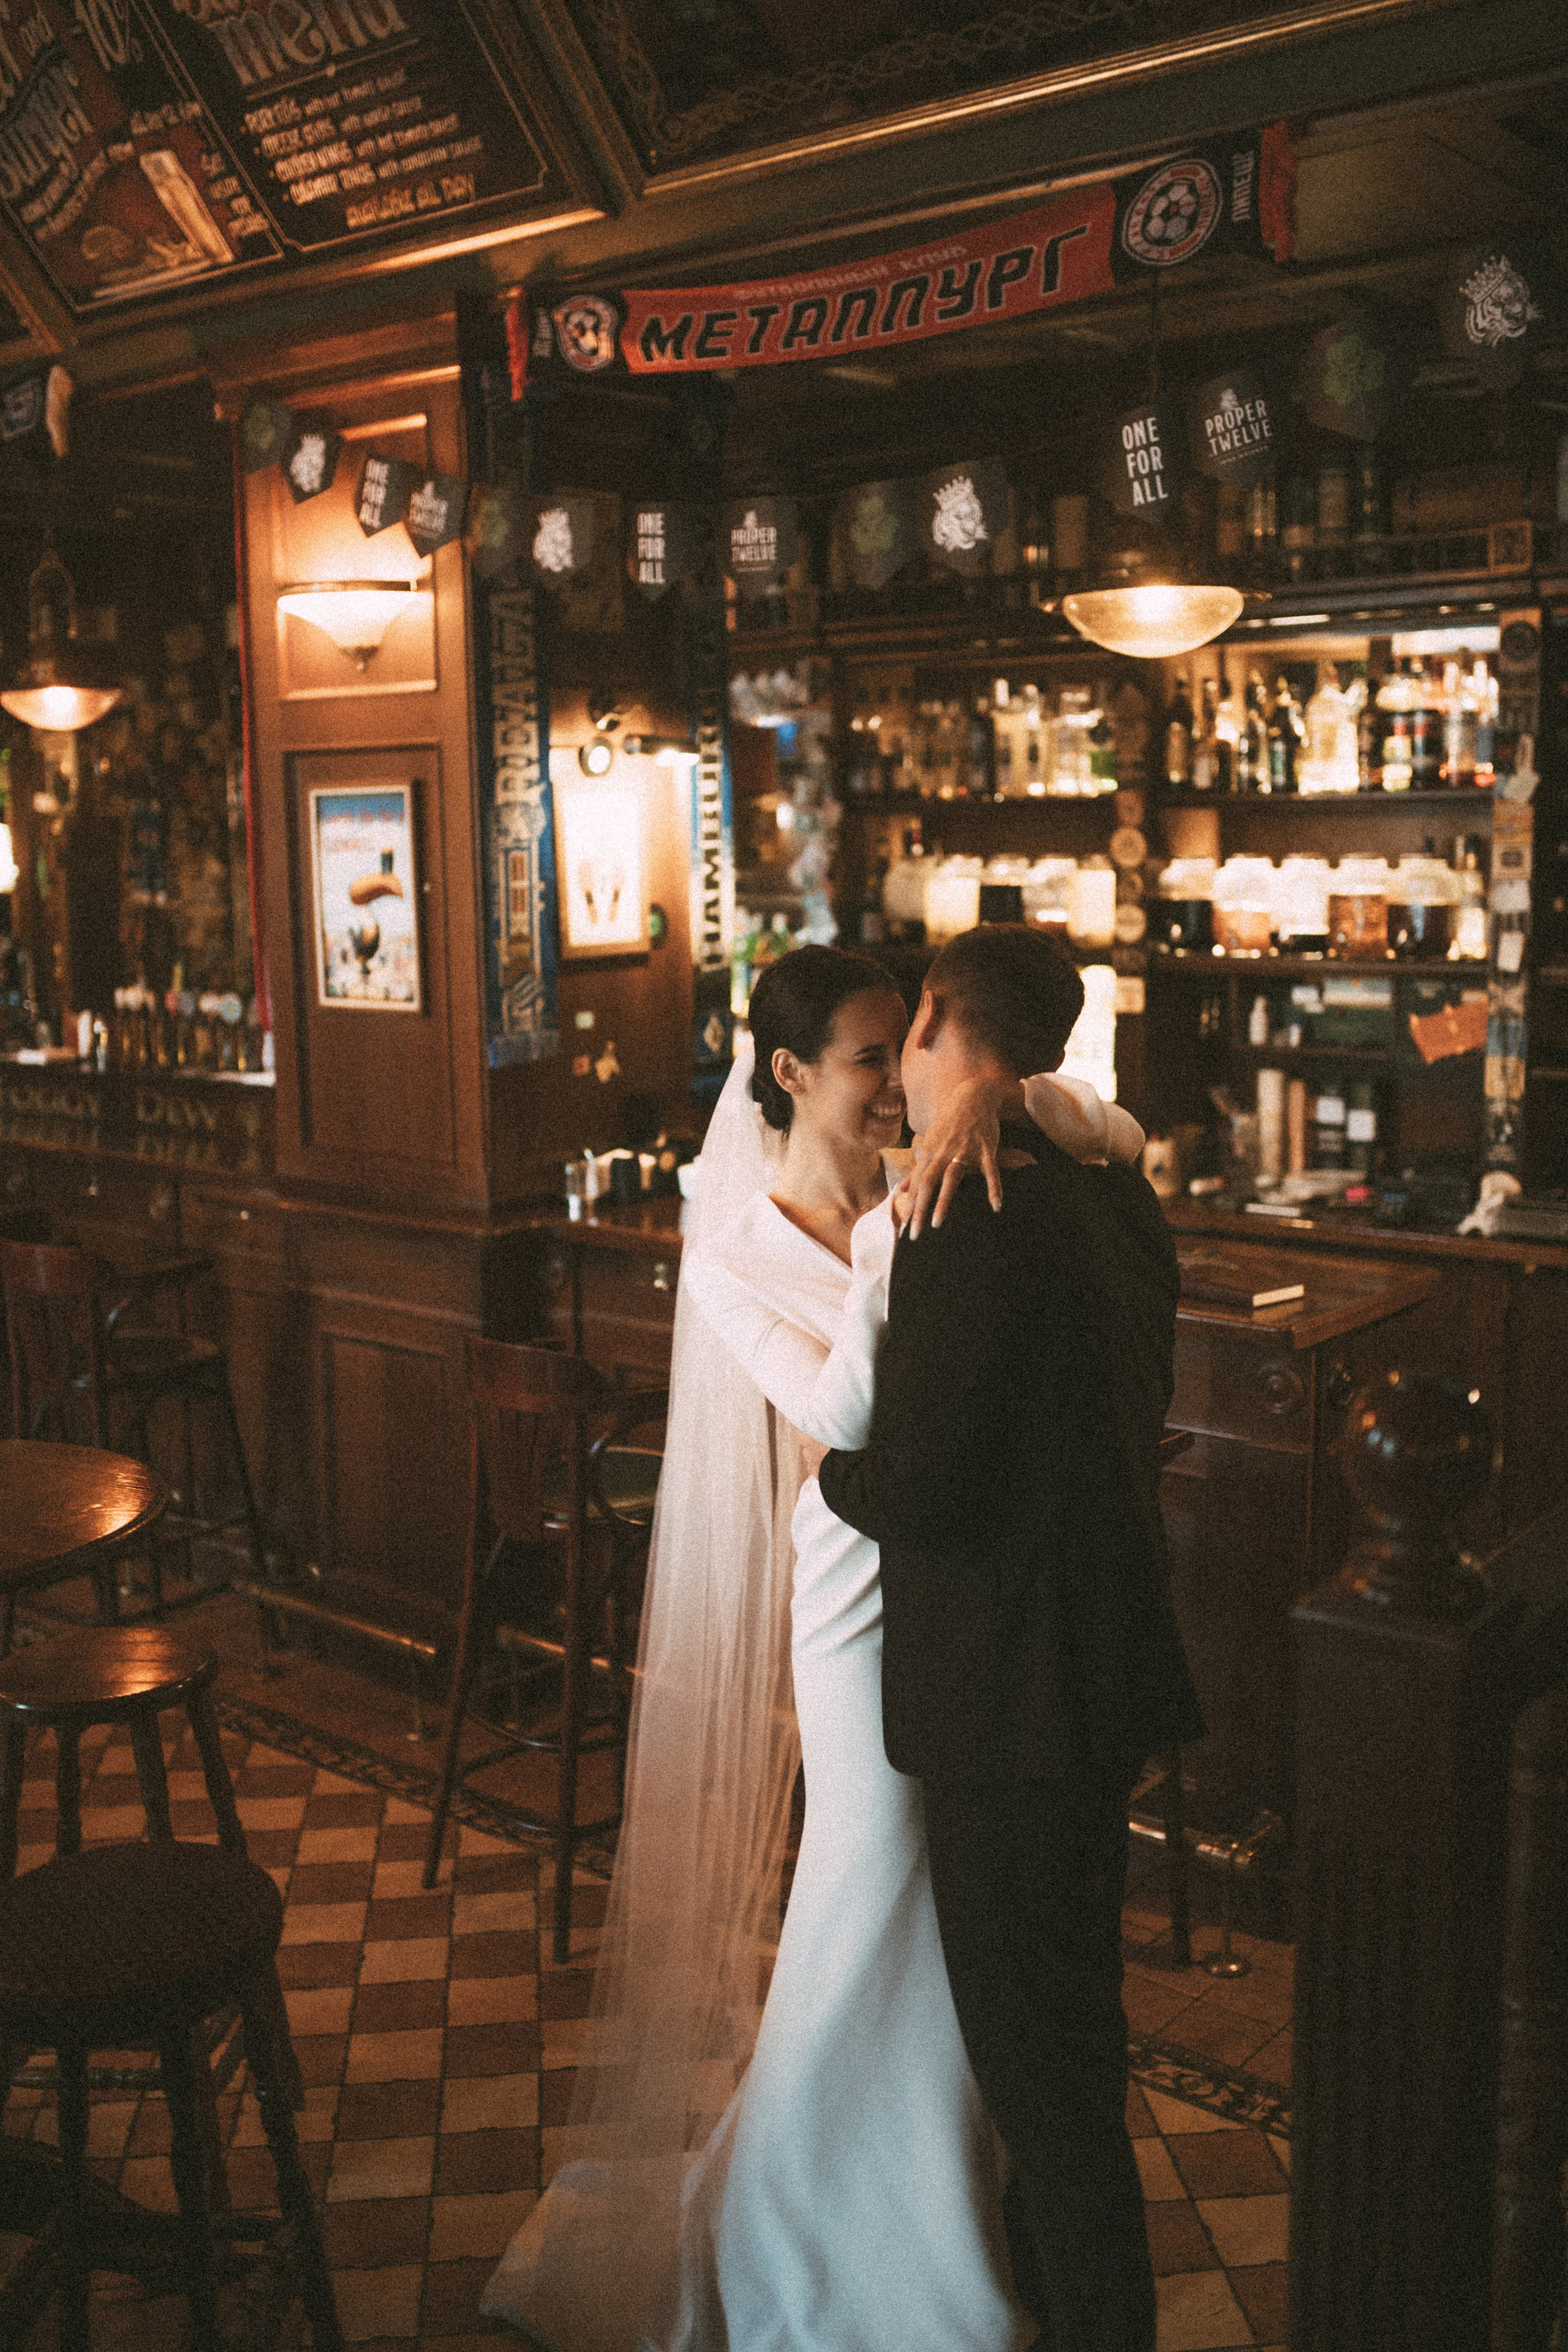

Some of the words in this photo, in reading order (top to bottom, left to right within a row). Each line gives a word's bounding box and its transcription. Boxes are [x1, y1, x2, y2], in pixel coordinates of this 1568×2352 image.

[1121, 417, 1160, 450] ONE
[1204, 399, 1267, 438] PROPER
[1208, 419, 1273, 456] TWELVE
[1126, 446, 1164, 479] FOR
[1133, 474, 1169, 507] ALL
[637, 512, 665, 535] ONE
[638, 537, 665, 559] FOR
